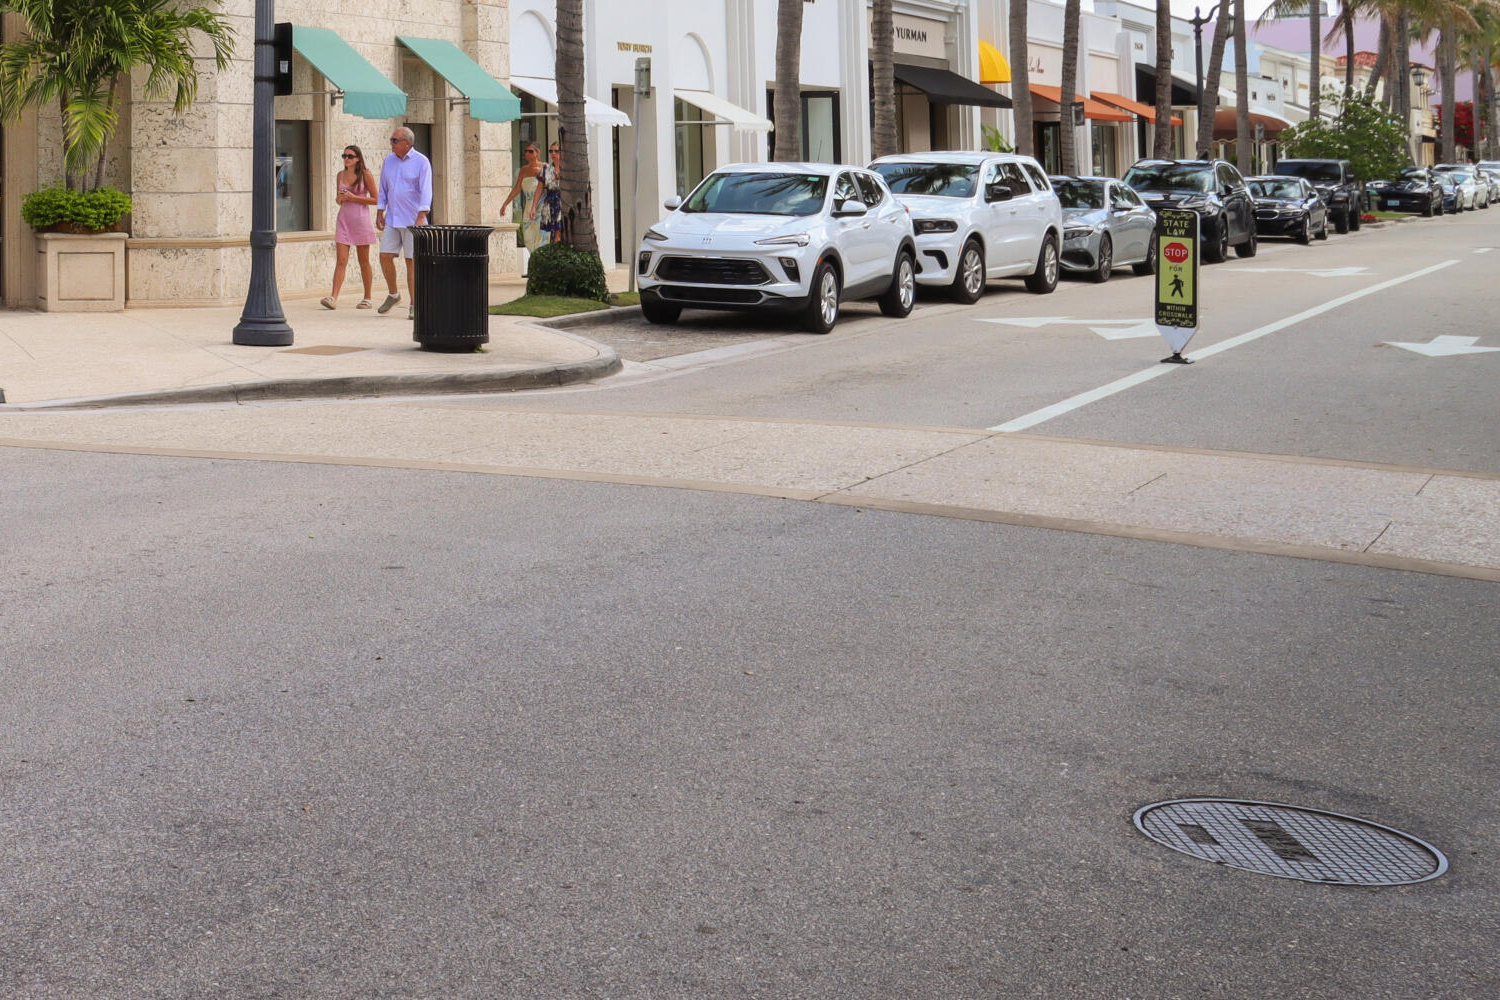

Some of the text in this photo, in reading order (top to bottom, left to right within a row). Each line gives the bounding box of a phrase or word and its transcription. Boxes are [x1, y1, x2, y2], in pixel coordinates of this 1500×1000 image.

[896, 26, 927, 43] YURMAN
[1164, 219, 1190, 228] STATE
[1167, 228, 1186, 236] LAW
[1164, 248, 1188, 257] STOP
[1159, 311, 1194, 319] CROSSWALK
